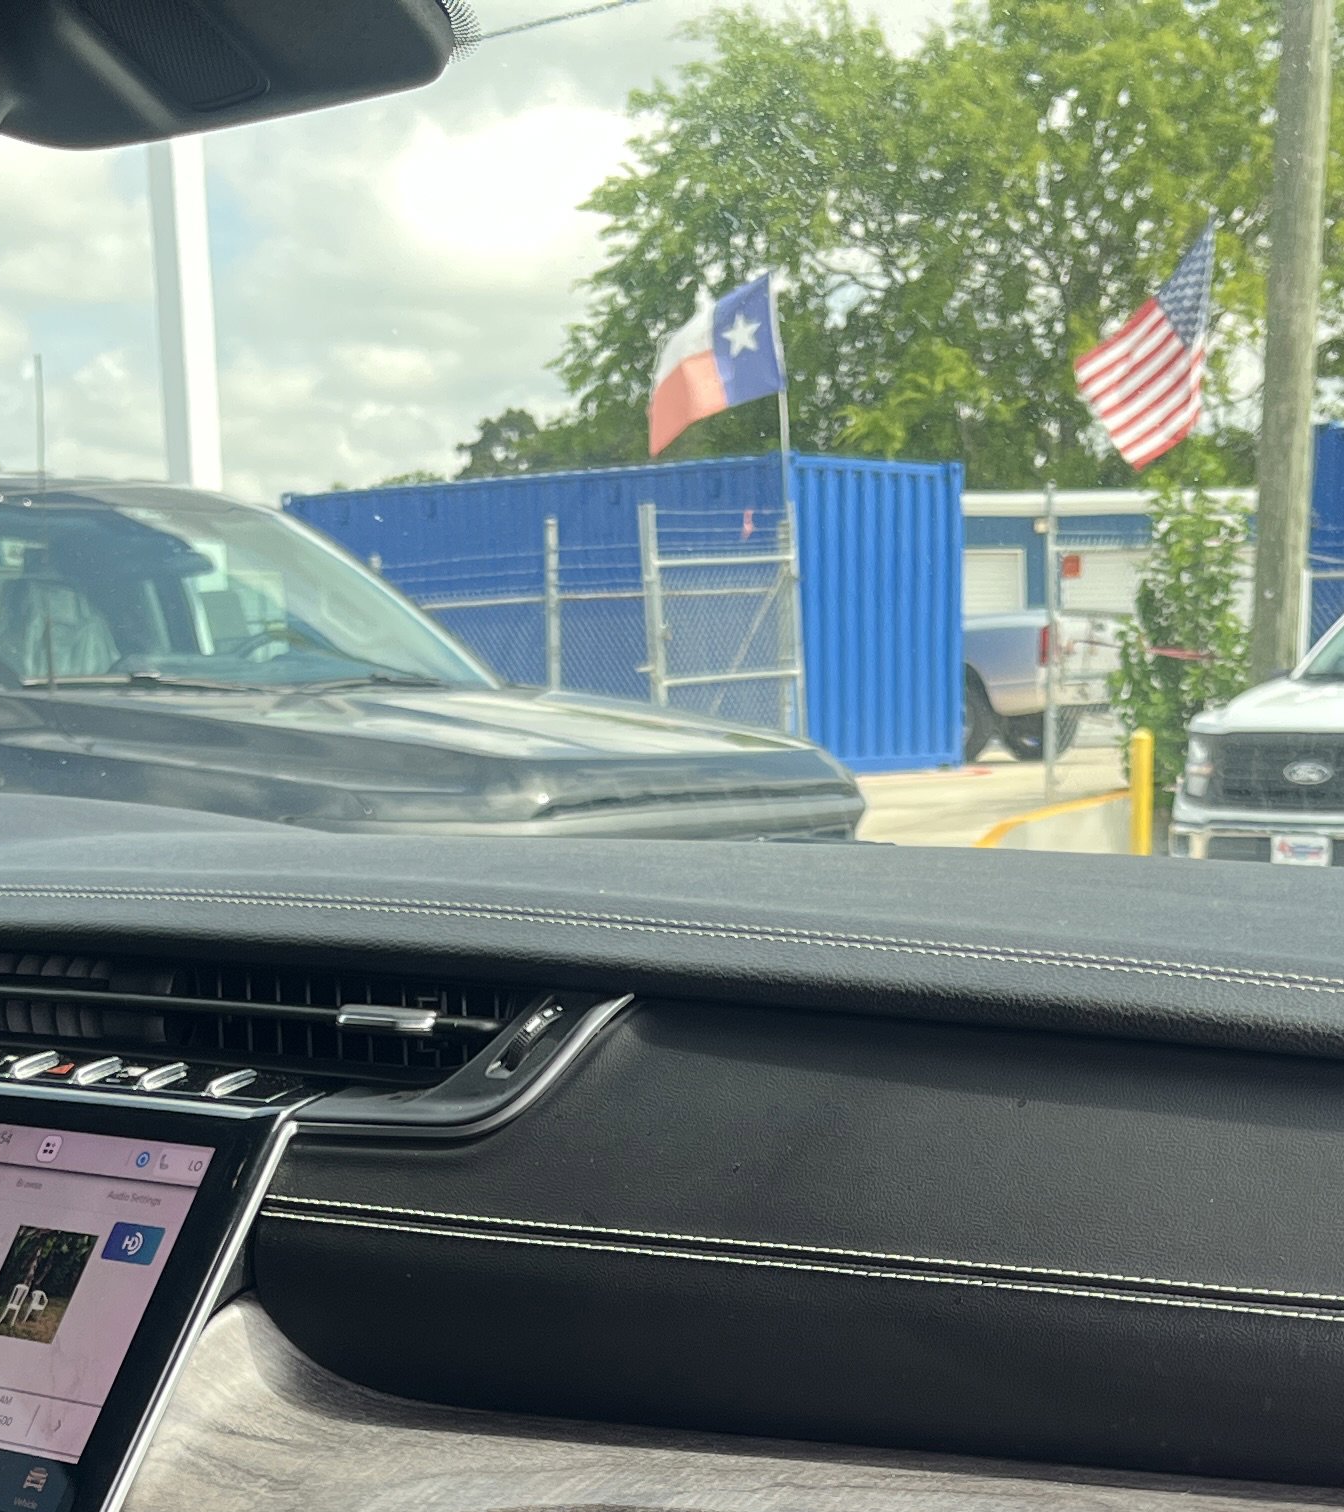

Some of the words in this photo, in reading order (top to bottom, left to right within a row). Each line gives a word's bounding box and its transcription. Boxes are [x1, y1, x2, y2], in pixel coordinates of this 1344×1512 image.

[187, 1159, 204, 1172] LO
[108, 1190, 131, 1201] Audio
[131, 1193, 162, 1207] Settings
[12, 1497, 38, 1511] Vehicle
